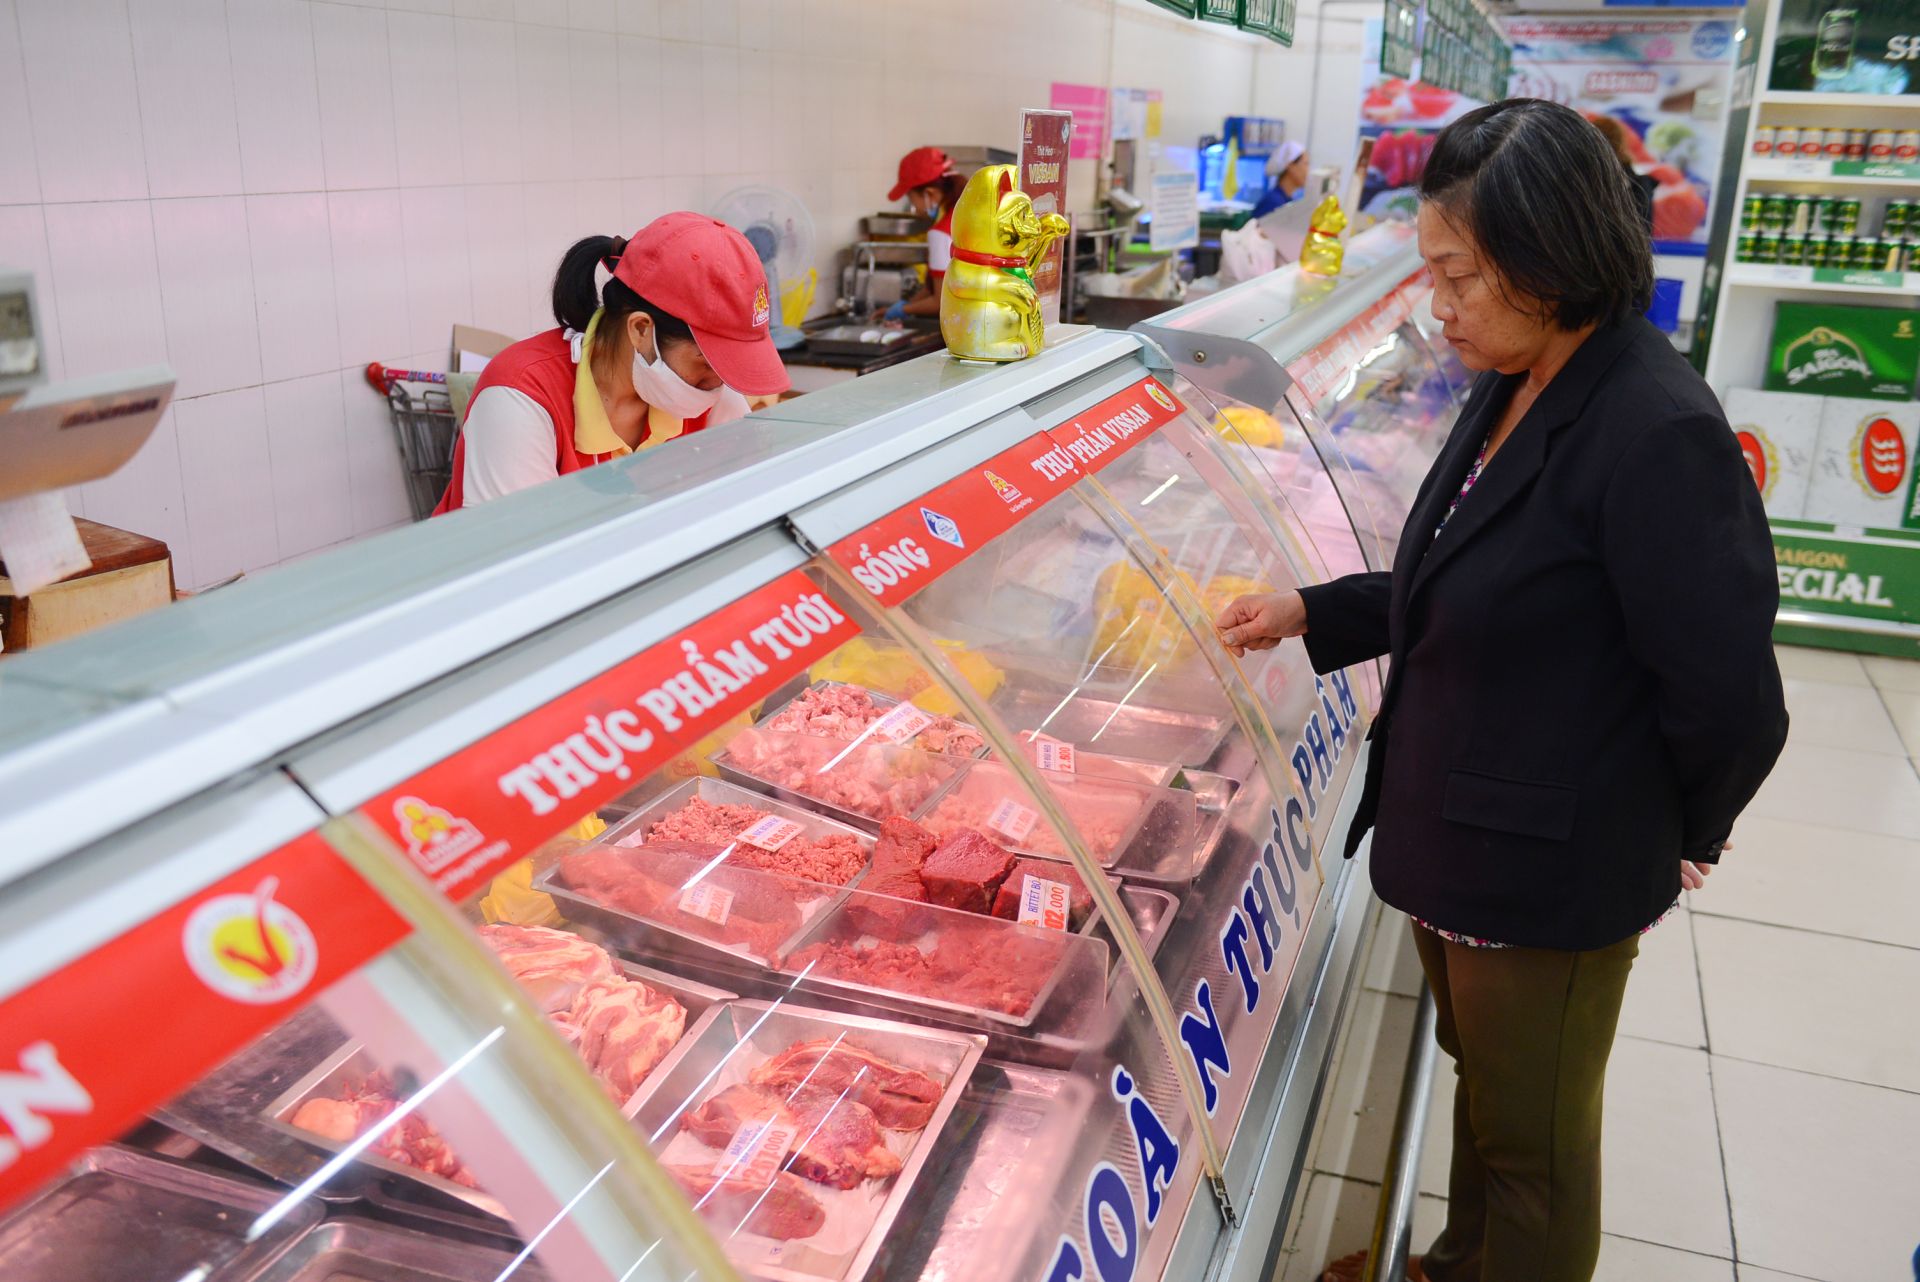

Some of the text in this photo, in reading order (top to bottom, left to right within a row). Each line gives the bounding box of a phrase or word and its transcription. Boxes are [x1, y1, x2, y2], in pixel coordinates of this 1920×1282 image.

[1028, 163, 1060, 184] VISSAN
[1102, 403, 1153, 440] VISSAN
[1776, 565, 1893, 608] ECIAL
[498, 537, 930, 815] THỰC PHẨM TƯƠI SỐNG
[1044, 886, 1065, 929] 02.000
